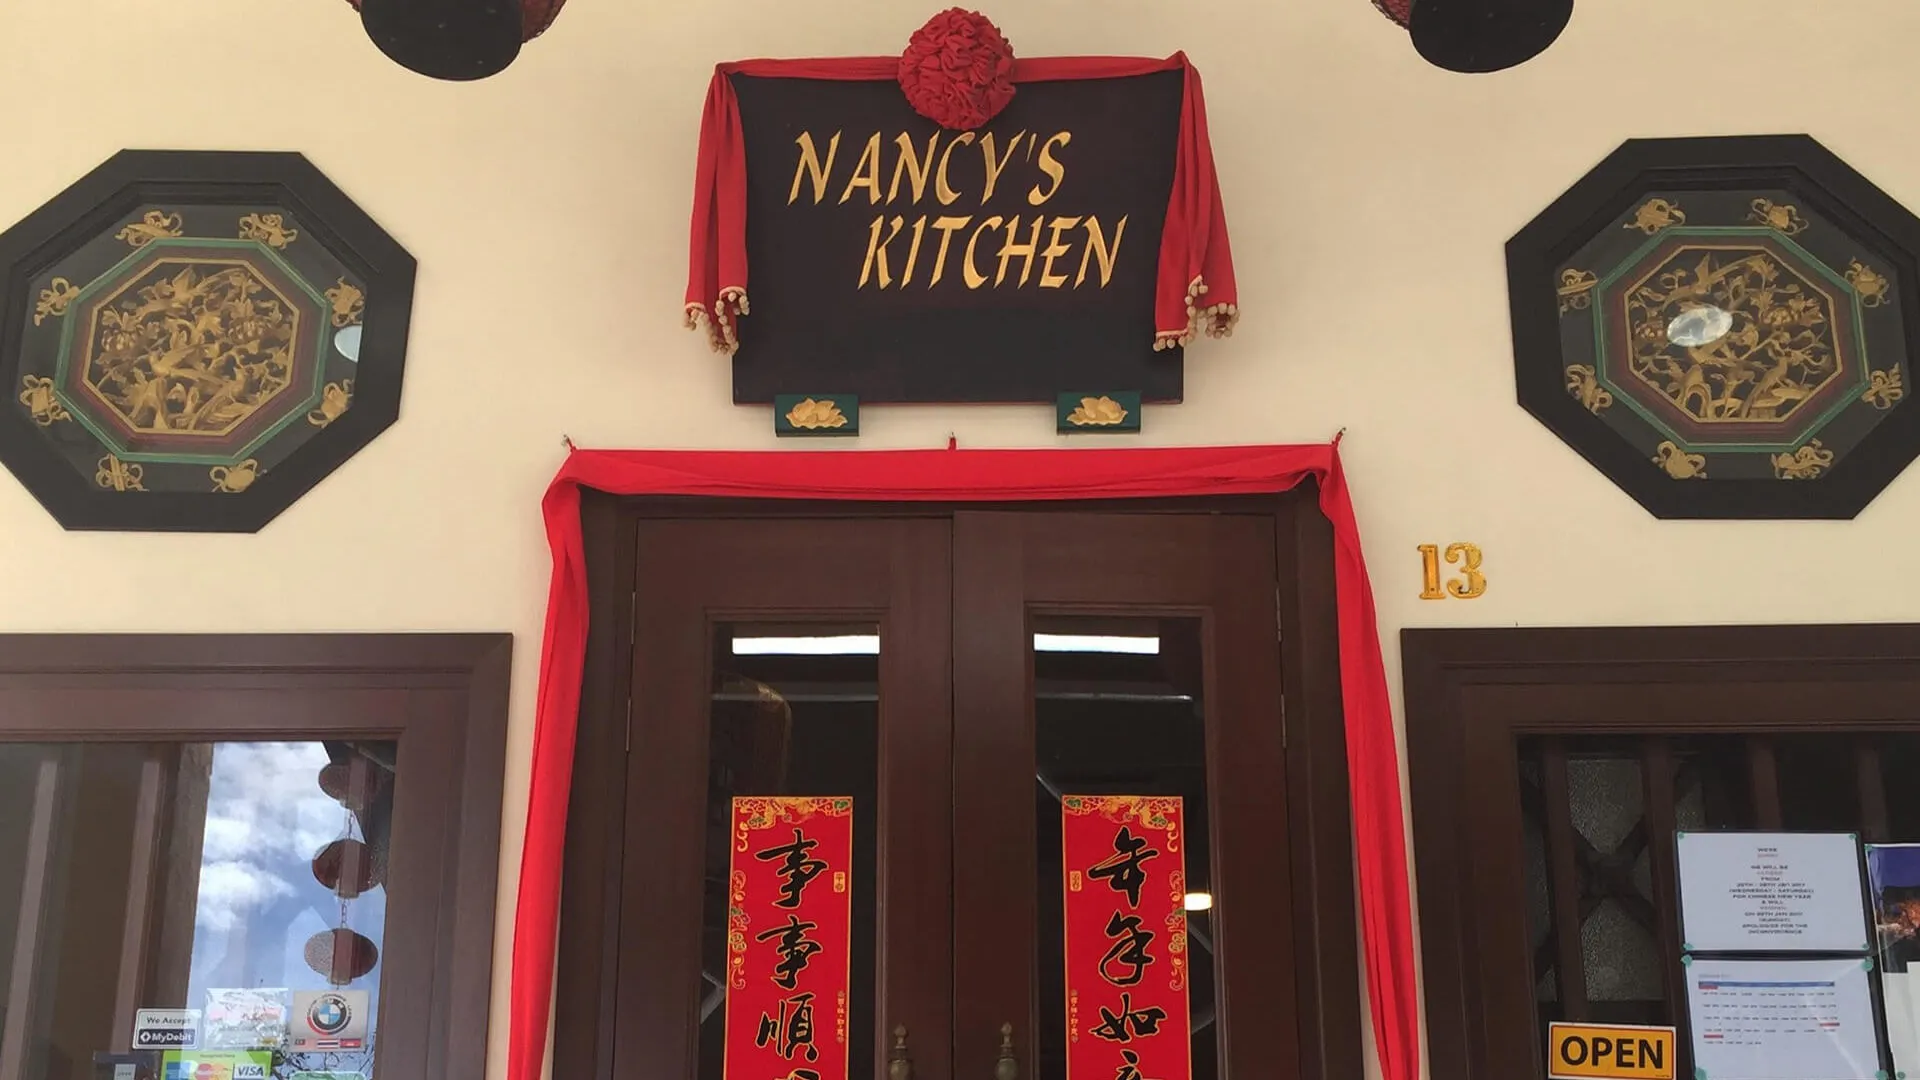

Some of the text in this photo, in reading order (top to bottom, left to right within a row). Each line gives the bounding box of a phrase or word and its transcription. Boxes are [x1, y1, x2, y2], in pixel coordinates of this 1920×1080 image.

[787, 129, 1072, 206] NANCY'S
[857, 213, 1129, 291] KITCHEN
[1416, 542, 1488, 600] 13
[753, 826, 830, 1080] 事事順
[146, 1016, 191, 1026] We Accept
[151, 1033, 193, 1043] MyDebit
[237, 1065, 265, 1077] VISA
[1560, 1035, 1664, 1069] OPEN
